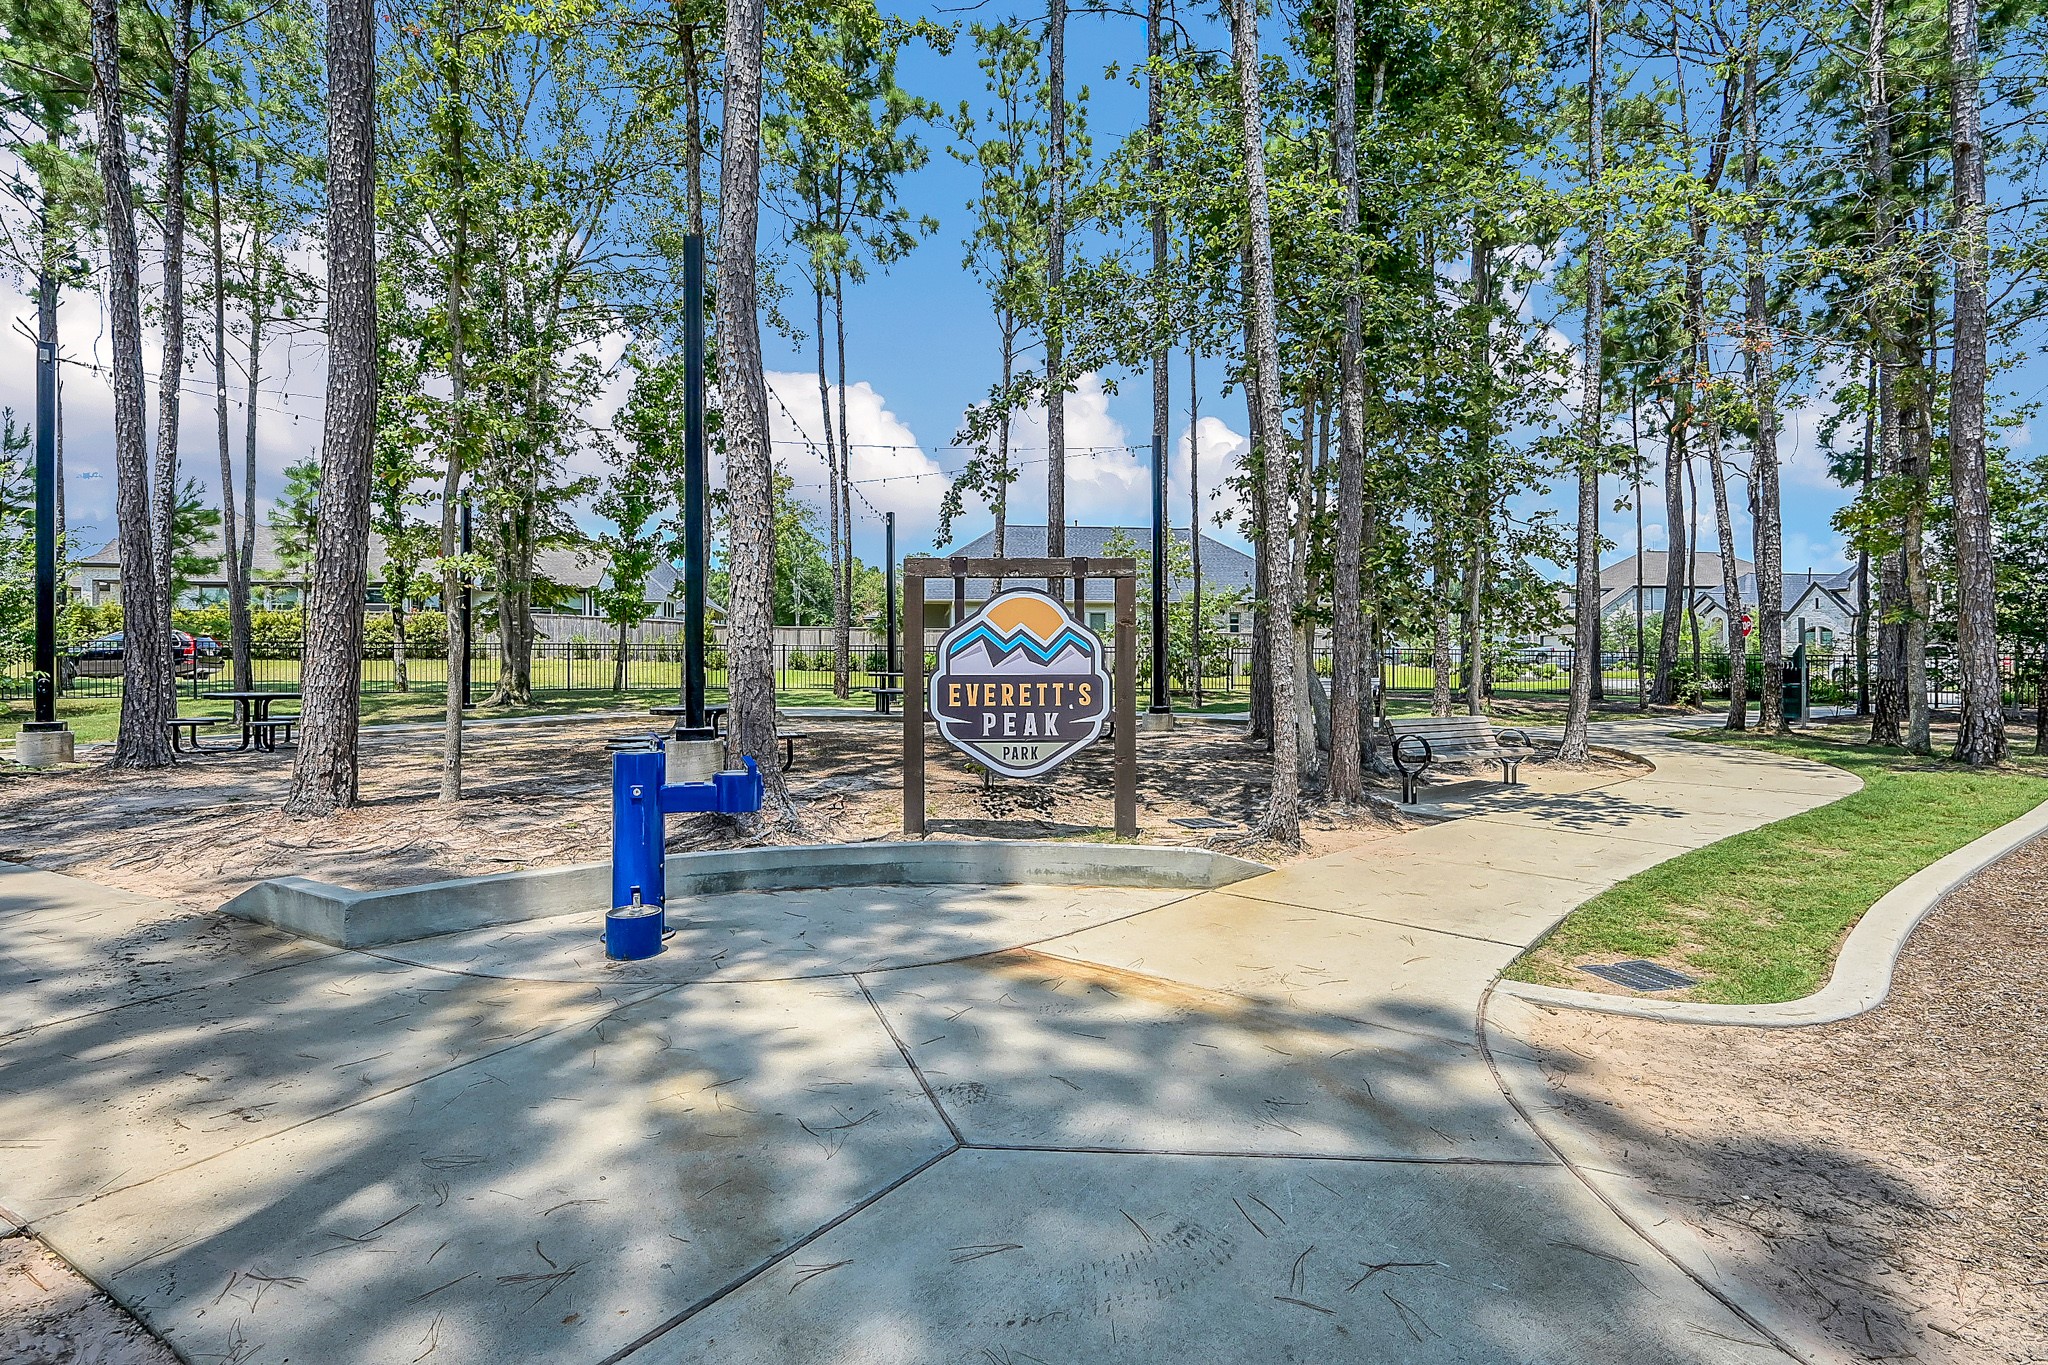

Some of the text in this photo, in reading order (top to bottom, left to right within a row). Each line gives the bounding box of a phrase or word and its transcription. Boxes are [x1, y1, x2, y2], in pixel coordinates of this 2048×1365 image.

[948, 682, 1092, 707] EVERETT'S
[982, 712, 1060, 737] PEAK
[1002, 746, 1039, 760] PARK
